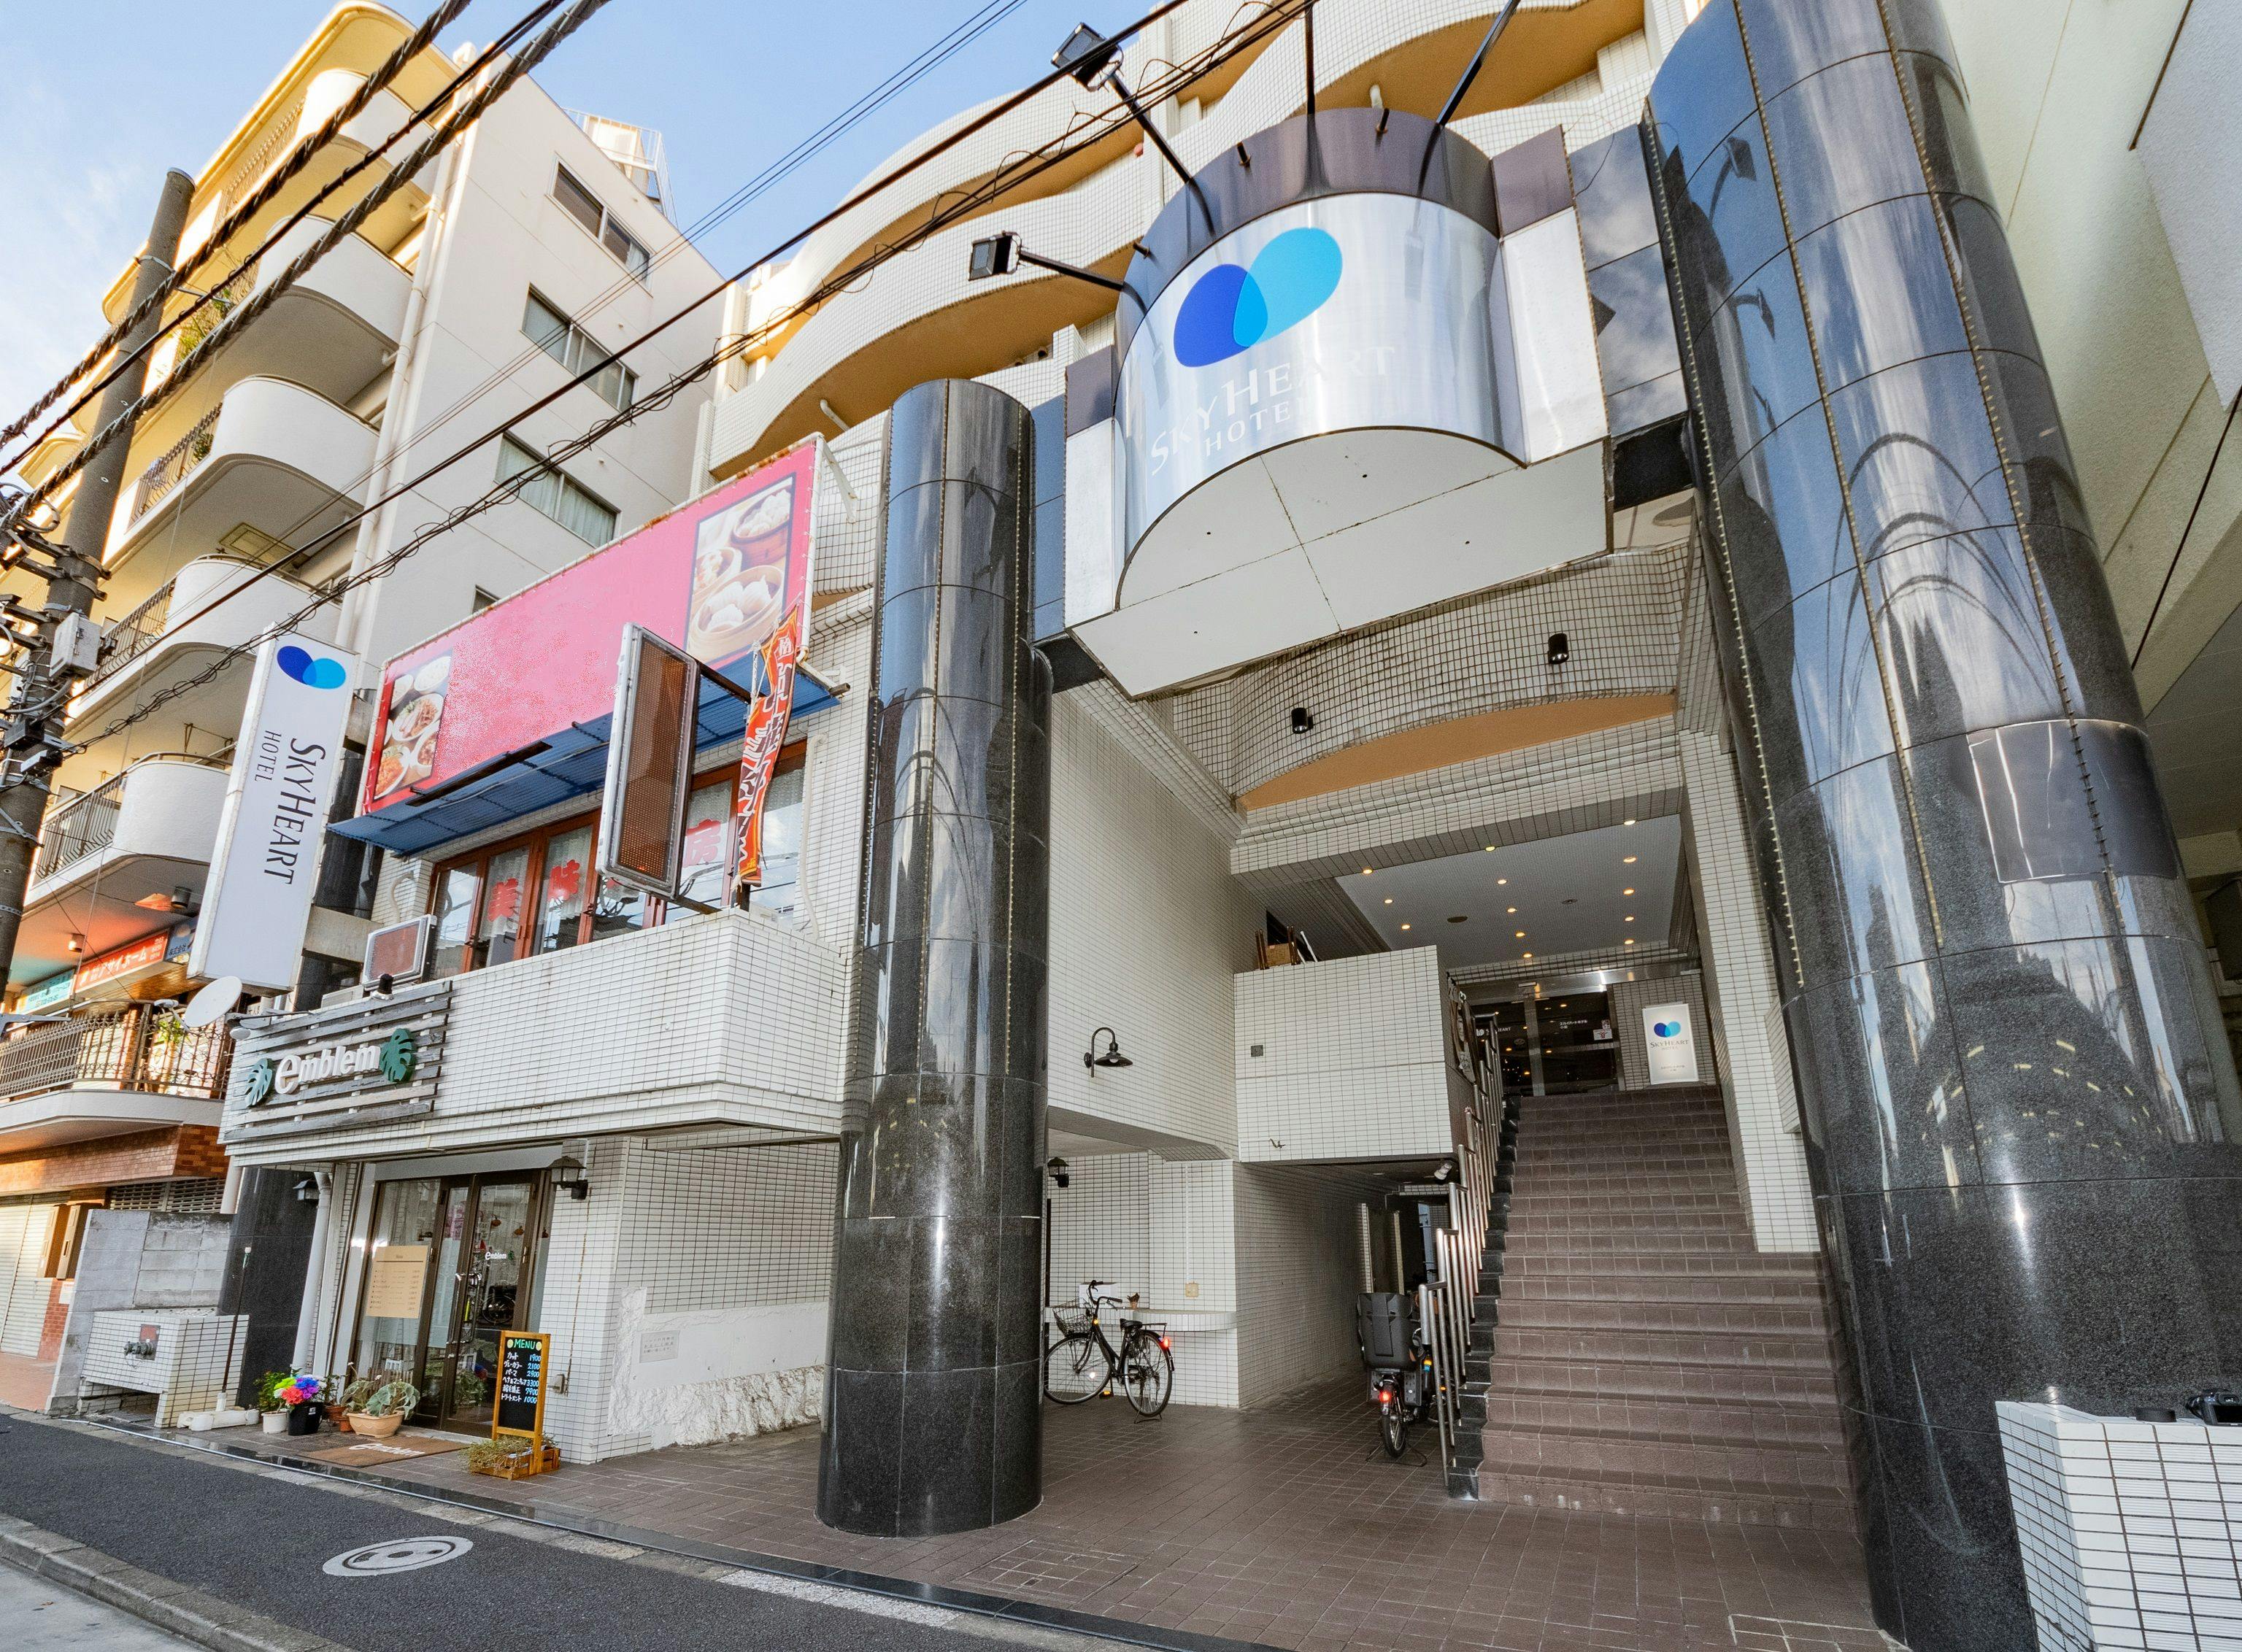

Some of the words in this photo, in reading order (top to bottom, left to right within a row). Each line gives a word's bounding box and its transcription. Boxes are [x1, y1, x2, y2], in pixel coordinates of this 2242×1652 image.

[254, 730, 282, 781] HOTEL
[274, 1044, 382, 1095] emblem
[514, 1338, 536, 1350] MENU
[507, 1352, 519, 1360] カット
[529, 1354, 542, 1362] 1900
[505, 1368, 517, 1377] パーマ
[525, 1379, 539, 1387] 3300
[525, 1387, 539, 1396] 7900
[523, 1396, 538, 1404] 1000
